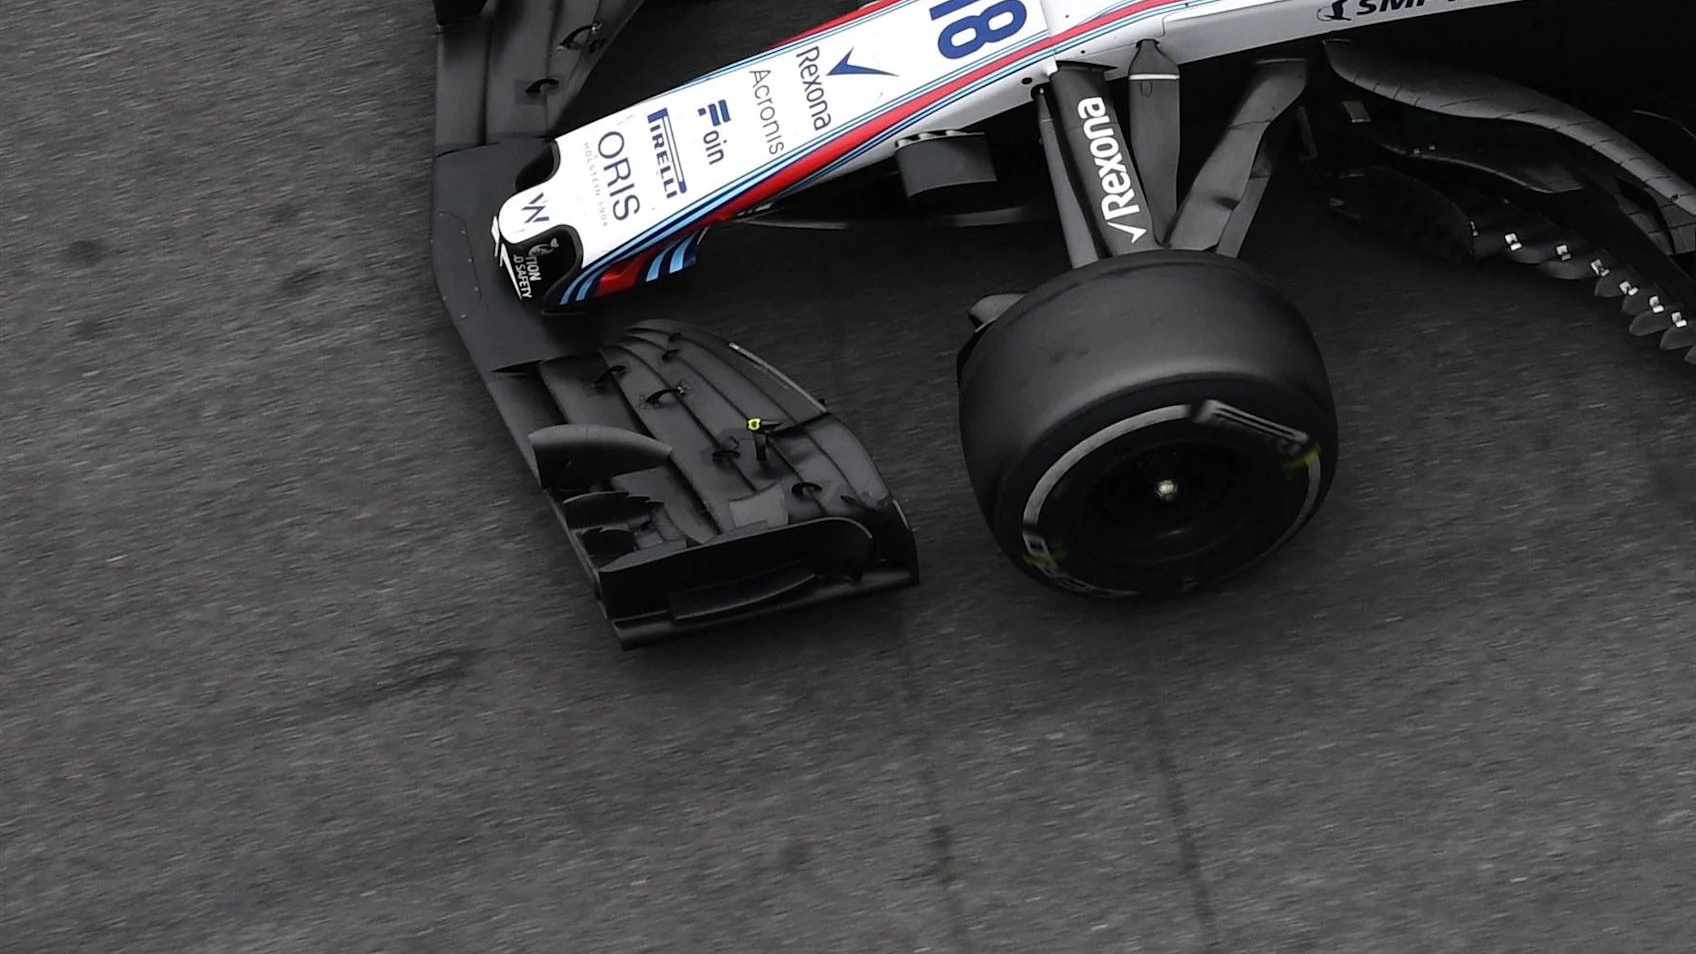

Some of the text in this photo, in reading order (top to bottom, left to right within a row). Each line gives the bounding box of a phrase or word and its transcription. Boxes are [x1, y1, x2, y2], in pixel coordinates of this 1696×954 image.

[749, 70, 785, 155] Acronis
[797, 46, 832, 131] Rexona
[598, 131, 640, 221] ORIS
[647, 107, 687, 199] PIRELLI
[1078, 96, 1140, 221] Rexona
[514, 263, 533, 299] SAFETY
